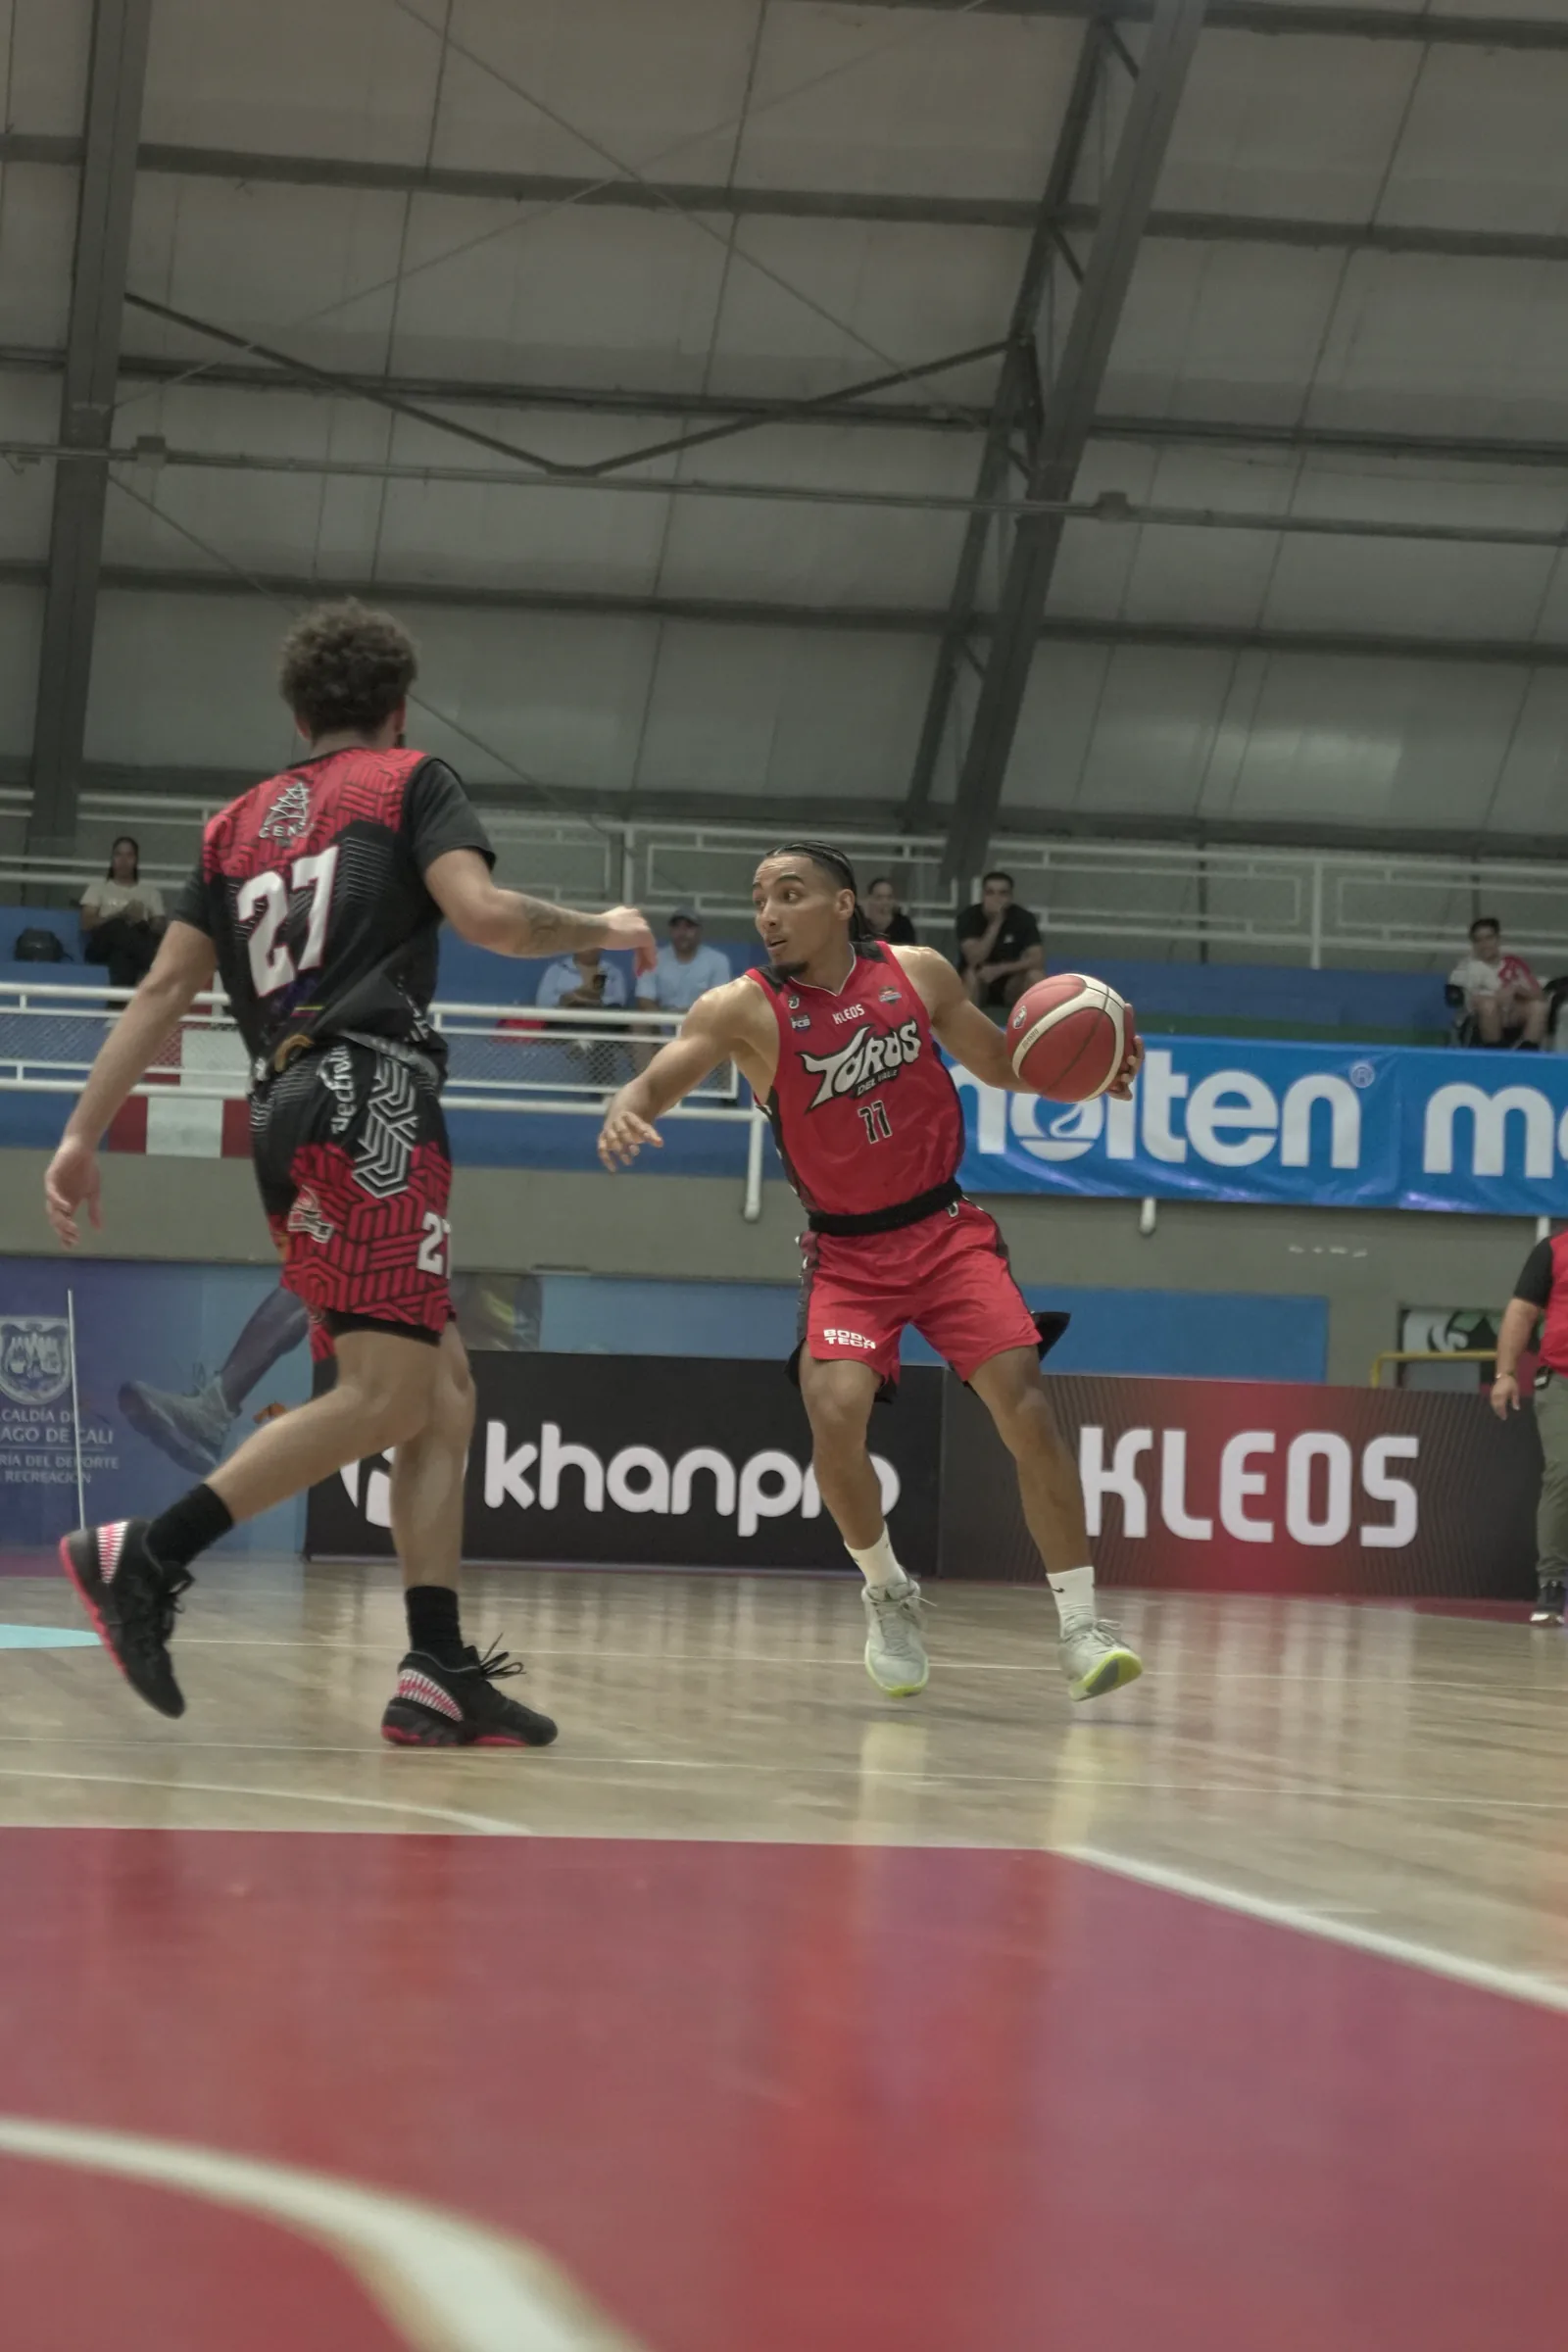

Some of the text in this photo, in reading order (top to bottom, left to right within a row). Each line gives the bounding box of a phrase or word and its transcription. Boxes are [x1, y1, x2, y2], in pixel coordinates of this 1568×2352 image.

[236, 845, 339, 998] 27
[832, 1004, 866, 1025] KLEOS
[797, 1017, 922, 1113] TOROS
[1423, 1082, 1568, 1179] m
[25, 1454, 50, 1468] DEL
[45, 1428, 72, 1444] DE
[1079, 1426, 1418, 1548] KLEOS
